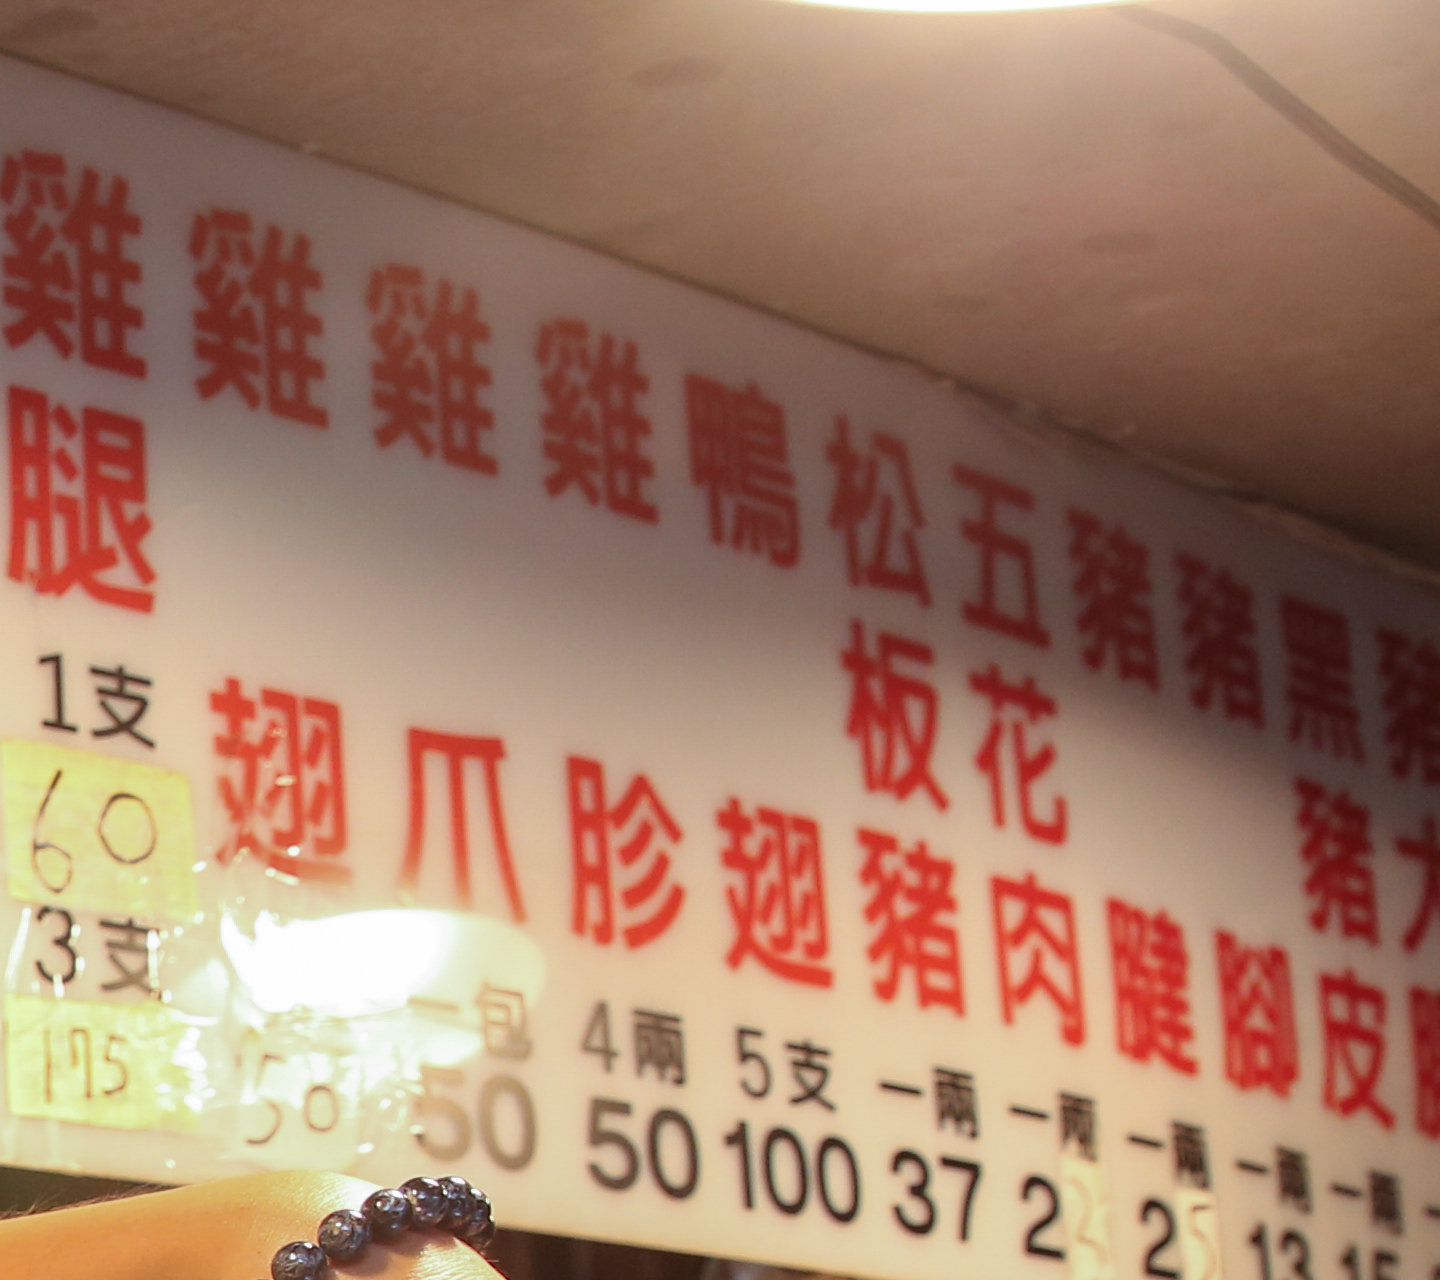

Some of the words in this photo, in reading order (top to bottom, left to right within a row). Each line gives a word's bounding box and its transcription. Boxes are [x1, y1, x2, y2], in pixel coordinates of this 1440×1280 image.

[38, 652, 156, 748] 1支
[33, 770, 157, 893] 60
[35, 906, 162, 1001] 3支
[583, 1001, 687, 1086] 4兩
[735, 1026, 837, 1112] 5支
[415, 1064, 537, 1170] 50
[588, 1097, 700, 1201] 50
[725, 1120, 860, 1225] 100
[891, 1149, 981, 1242] 37
